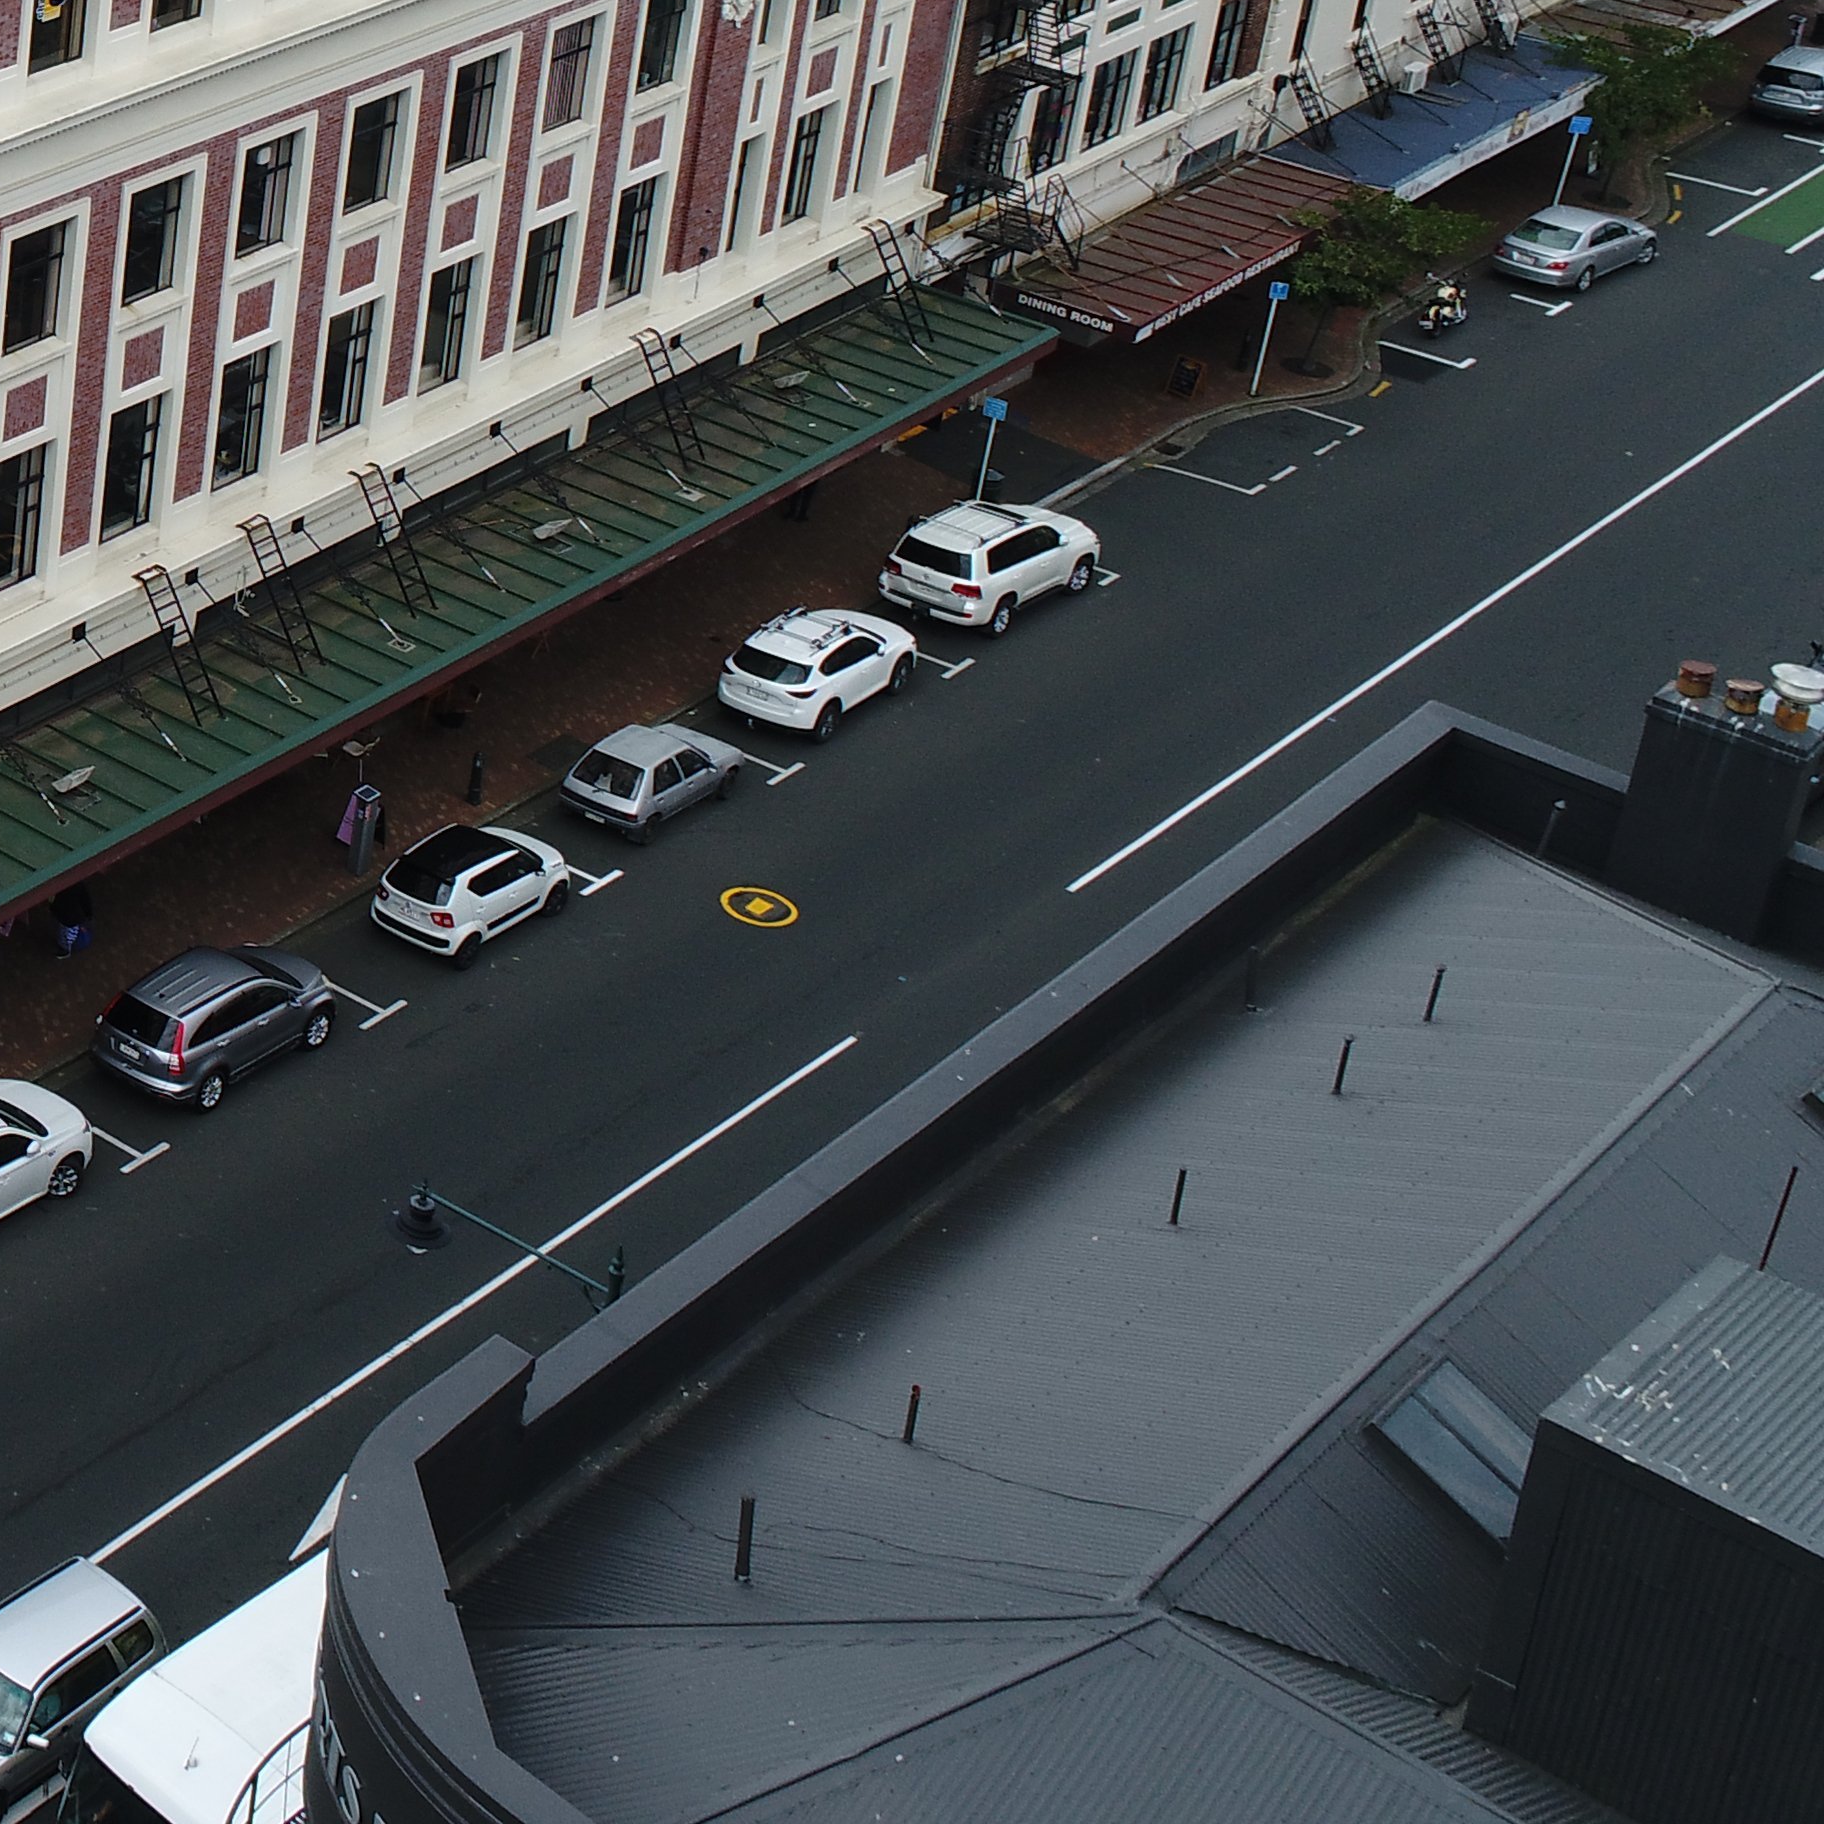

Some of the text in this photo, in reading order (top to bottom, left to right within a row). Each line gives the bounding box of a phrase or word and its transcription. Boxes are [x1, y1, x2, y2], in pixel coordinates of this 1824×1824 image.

[1179, 294, 1203, 317] CAFE
[1203, 271, 1244, 303] SEAFOOD
[1244, 240, 1302, 280] RESTAURANT
[1018, 294, 1114, 332] DINING ROOM
